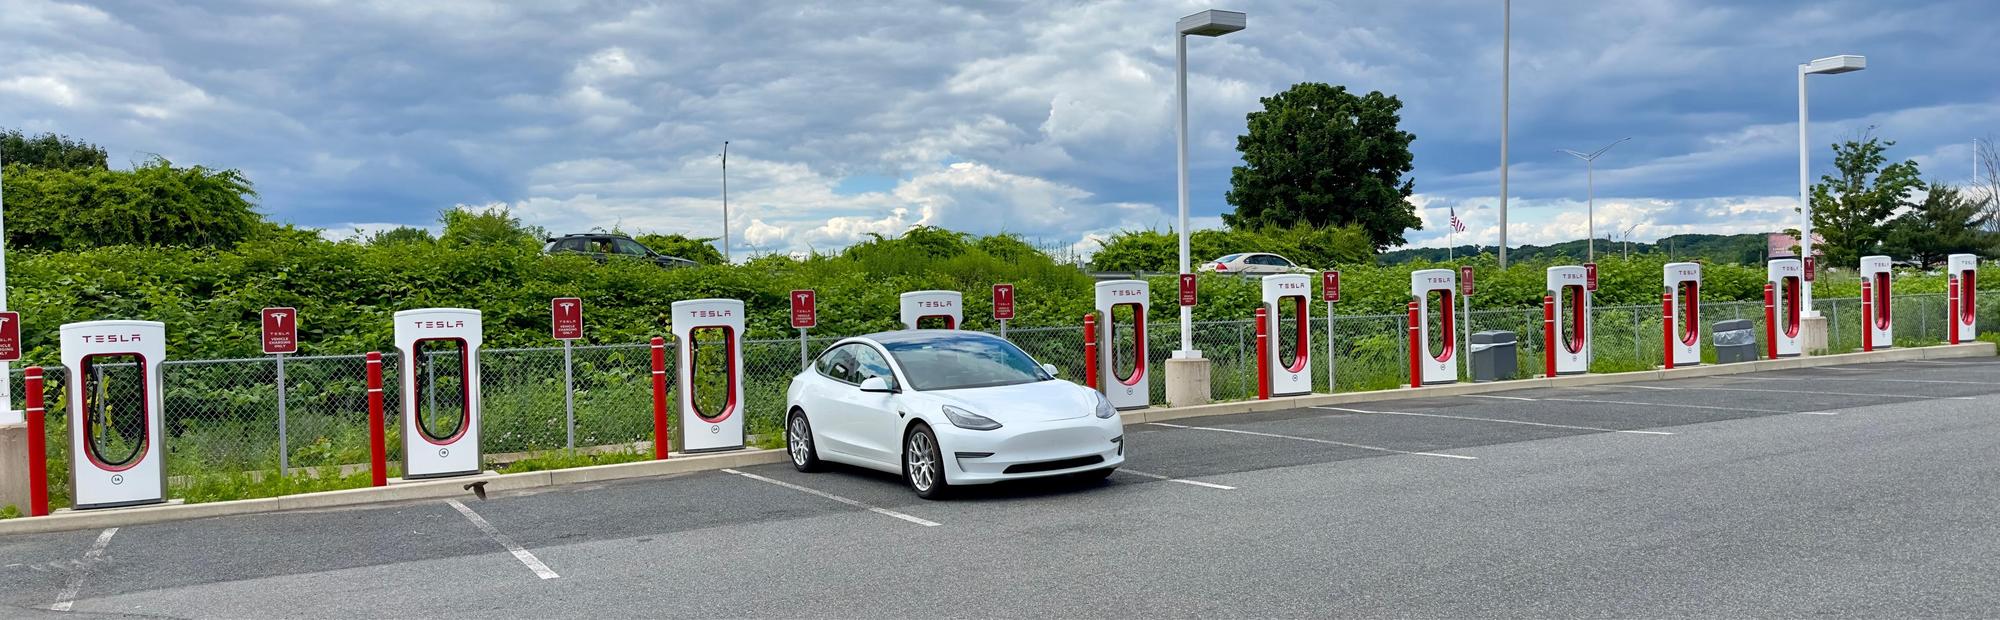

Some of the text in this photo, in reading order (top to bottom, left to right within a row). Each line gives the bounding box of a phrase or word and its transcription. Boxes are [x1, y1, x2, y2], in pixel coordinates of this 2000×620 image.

[690, 310, 731, 318] TESLA
[414, 320, 464, 329] TESLA
[82, 334, 141, 343] TESLA
